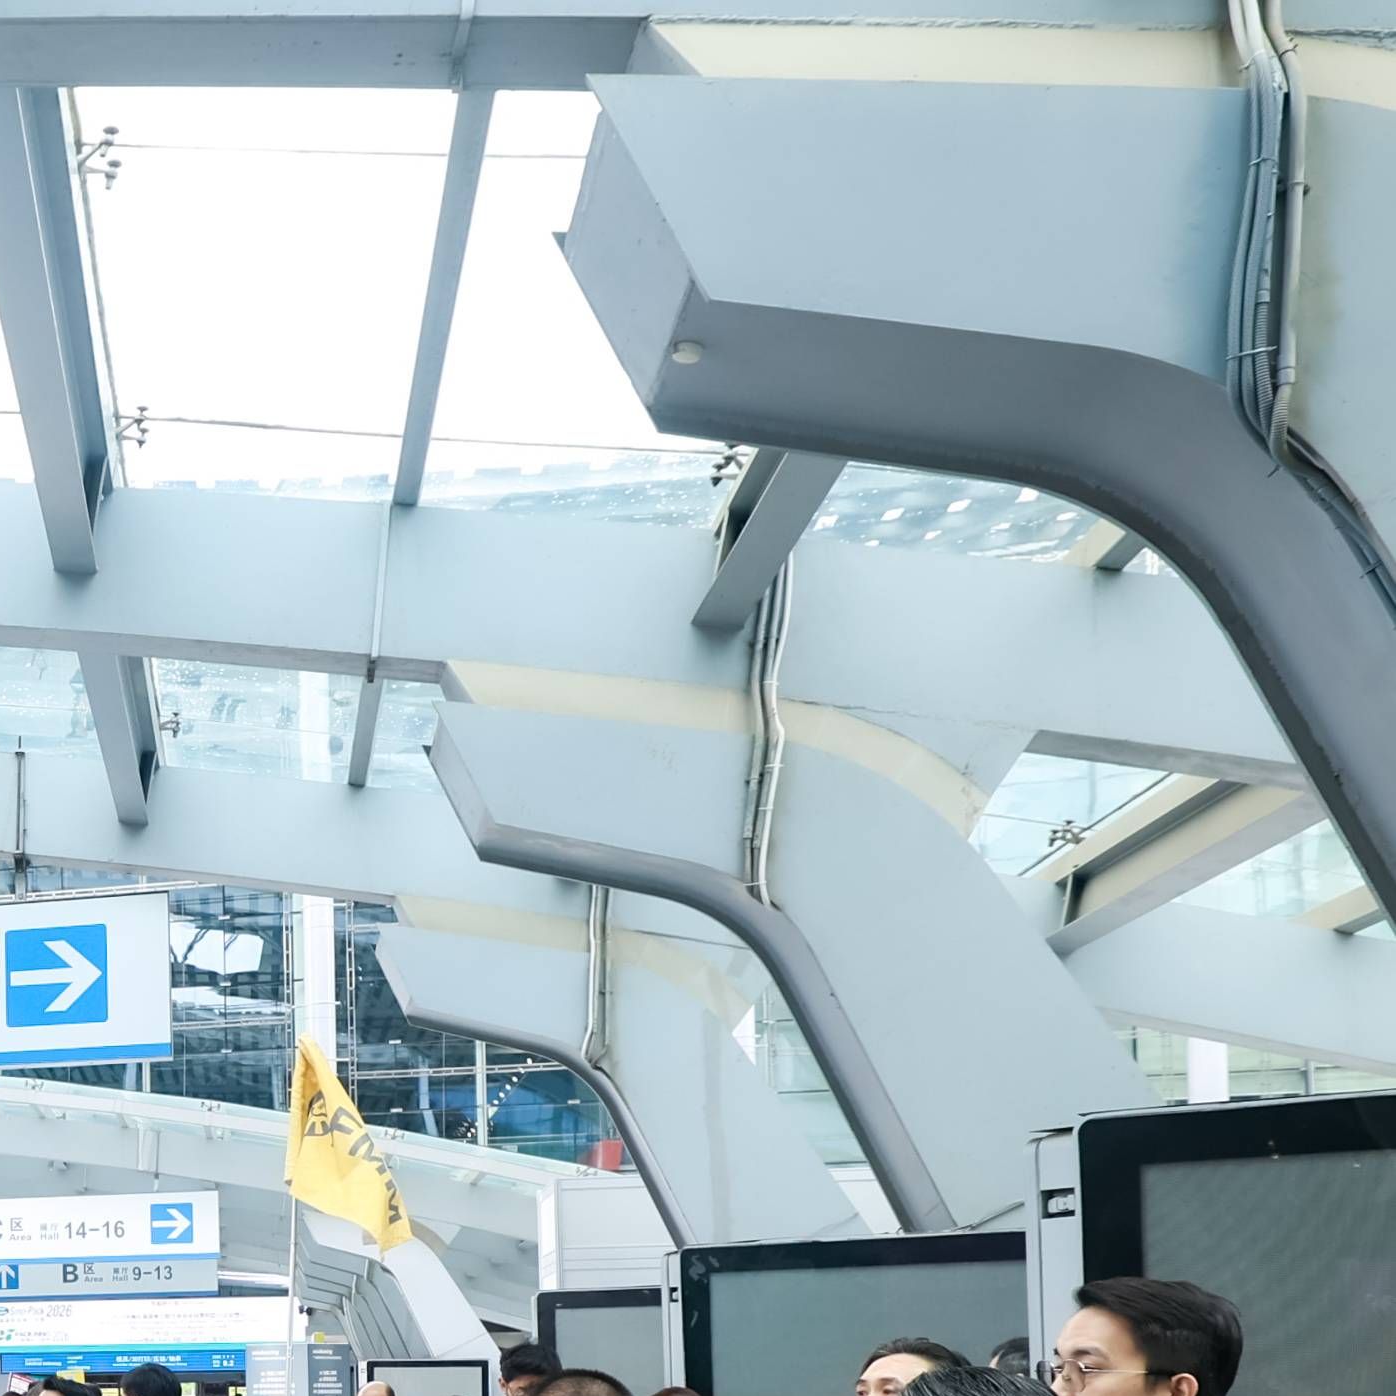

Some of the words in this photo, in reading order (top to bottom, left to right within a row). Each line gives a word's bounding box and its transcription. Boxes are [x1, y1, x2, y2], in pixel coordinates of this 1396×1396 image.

[10, 1217, 23, 1231] 区
[64, 1220, 126, 1239] 14-16
[8, 1232, 32, 1241] Area
[39, 1232, 59, 1241] Hall
[62, 1263, 79, 1283] B
[112, 1274, 129, 1282] Hall
[132, 1265, 173, 1281] 9-13
[83, 1275, 104, 1283] Area
